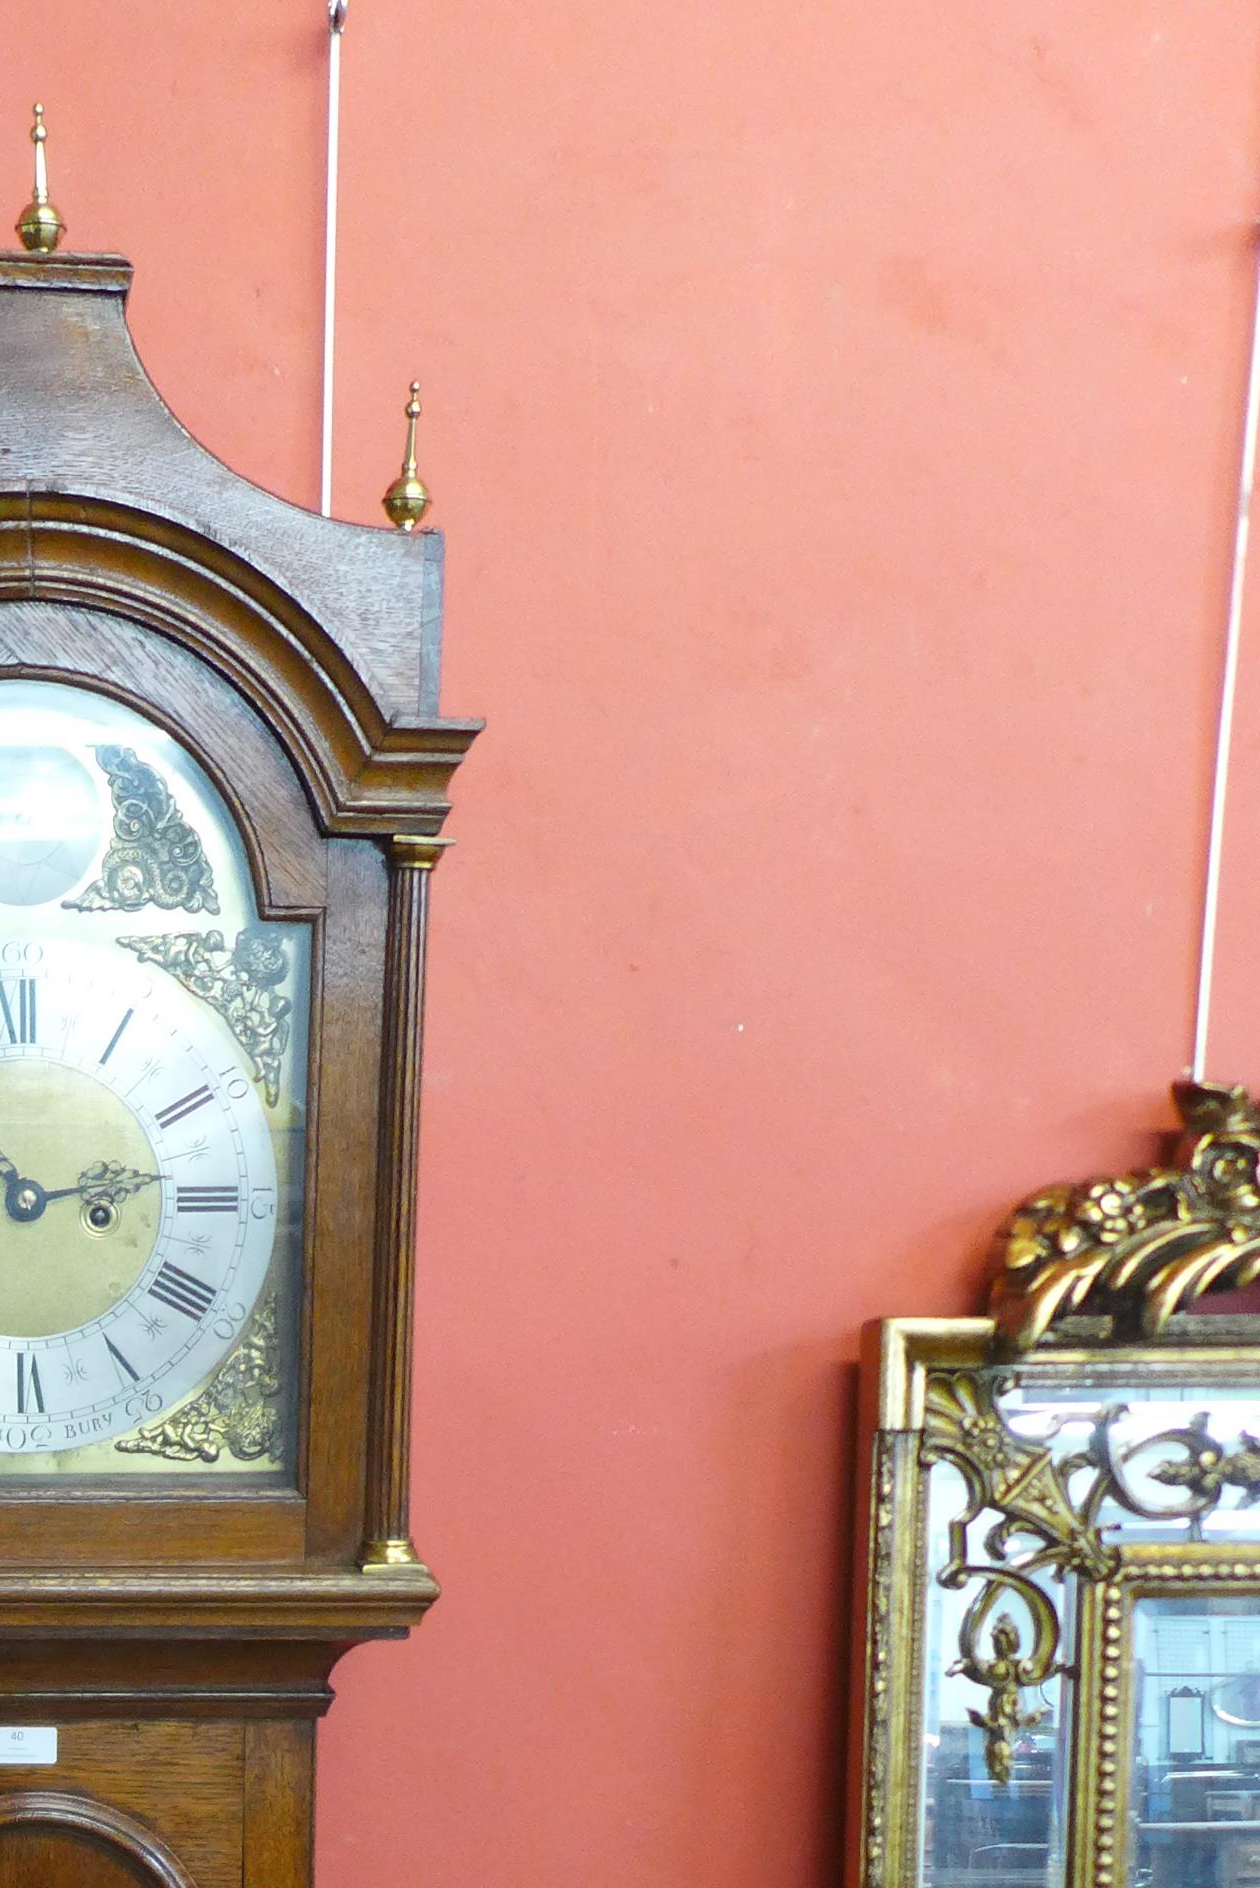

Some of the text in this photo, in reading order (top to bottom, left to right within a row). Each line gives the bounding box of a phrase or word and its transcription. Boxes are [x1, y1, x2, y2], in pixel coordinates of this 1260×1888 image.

[1, 940, 44, 965] 60
[98, 1007, 135, 1066] I
[218, 1066, 250, 1100] 10
[153, 1083, 216, 1130] II
[175, 1185, 239, 1213] III
[250, 1186, 276, 1220] 15
[147, 1260, 218, 1322] IIII
[212, 1302, 247, 1340] 20
[101, 1331, 141, 1389] V
[16, 1352, 45, 1415] VI
[64, 1411, 113, 1439] BURY
